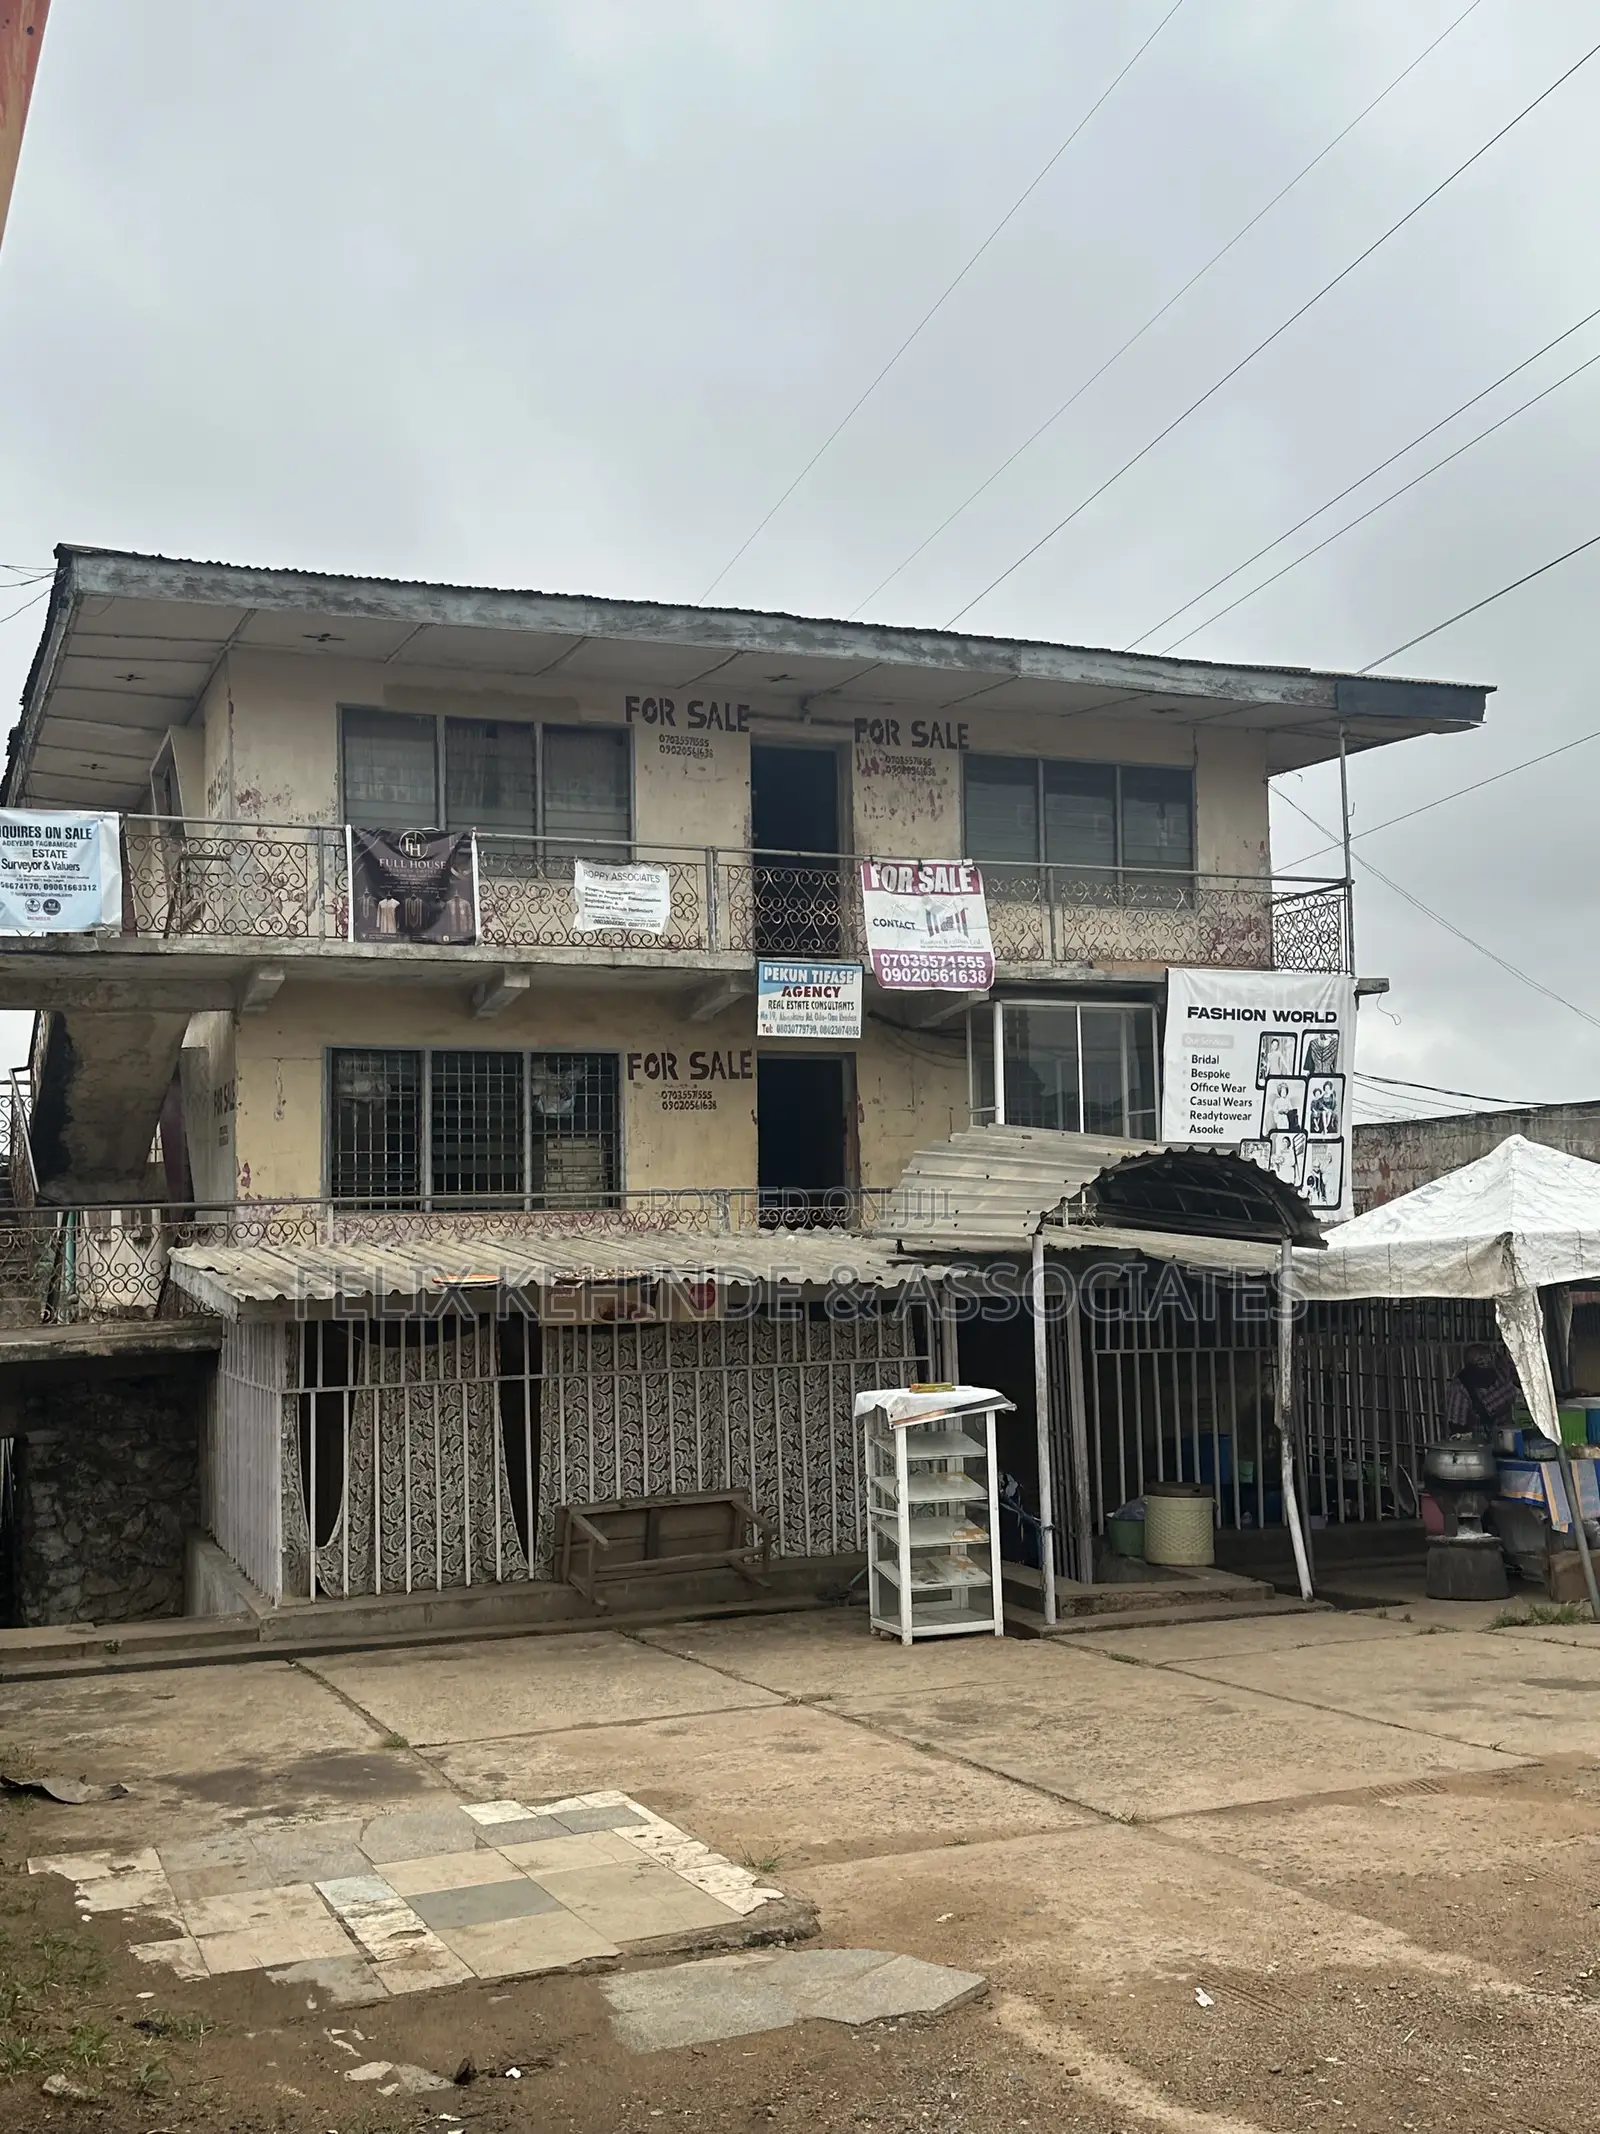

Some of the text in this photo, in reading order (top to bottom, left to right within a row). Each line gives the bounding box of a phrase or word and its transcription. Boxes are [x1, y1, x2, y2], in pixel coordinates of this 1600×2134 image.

[625, 696, 750, 732] FOR SALE
[855, 718, 969, 750] FOR SALE
[0, 825, 92, 840] QUIRES ON SALE
[32, 849, 68, 859] ESTATE
[1, 858, 80, 872] Surveyor & Valuers
[379, 859, 447, 869] FULL HOUSE
[611, 873, 661, 883] ASSOCIATES
[870, 863, 973, 893] FOR SALE
[873, 918, 915, 930] CONTACT
[880, 954, 986, 968] 07035571555
[764, 967, 853, 984] PEKUN TIFASE
[882, 968, 987, 983] 09020561638
[781, 986, 841, 998] AGENCY
[768, 1000, 854, 1010] REAL ESTATE CONSULTANTS
[1187, 1007, 1337, 1023] FASHION WORLD
[1191, 1054, 1220, 1064] Bridal
[627, 1051, 753, 1080] FOR SALE
[1191, 1068, 1231, 1080] Bespoke
[1190, 1082, 1246, 1093] Office Wear
[661, 1091, 712, 1100] 07035571555
[1190, 1096, 1252, 1107] Casual Wears
[662, 1101, 717, 1110] 09020561638
[1190, 1110, 1252, 1121] Readytowear
[1189, 1124, 1224, 1134] Asooke
